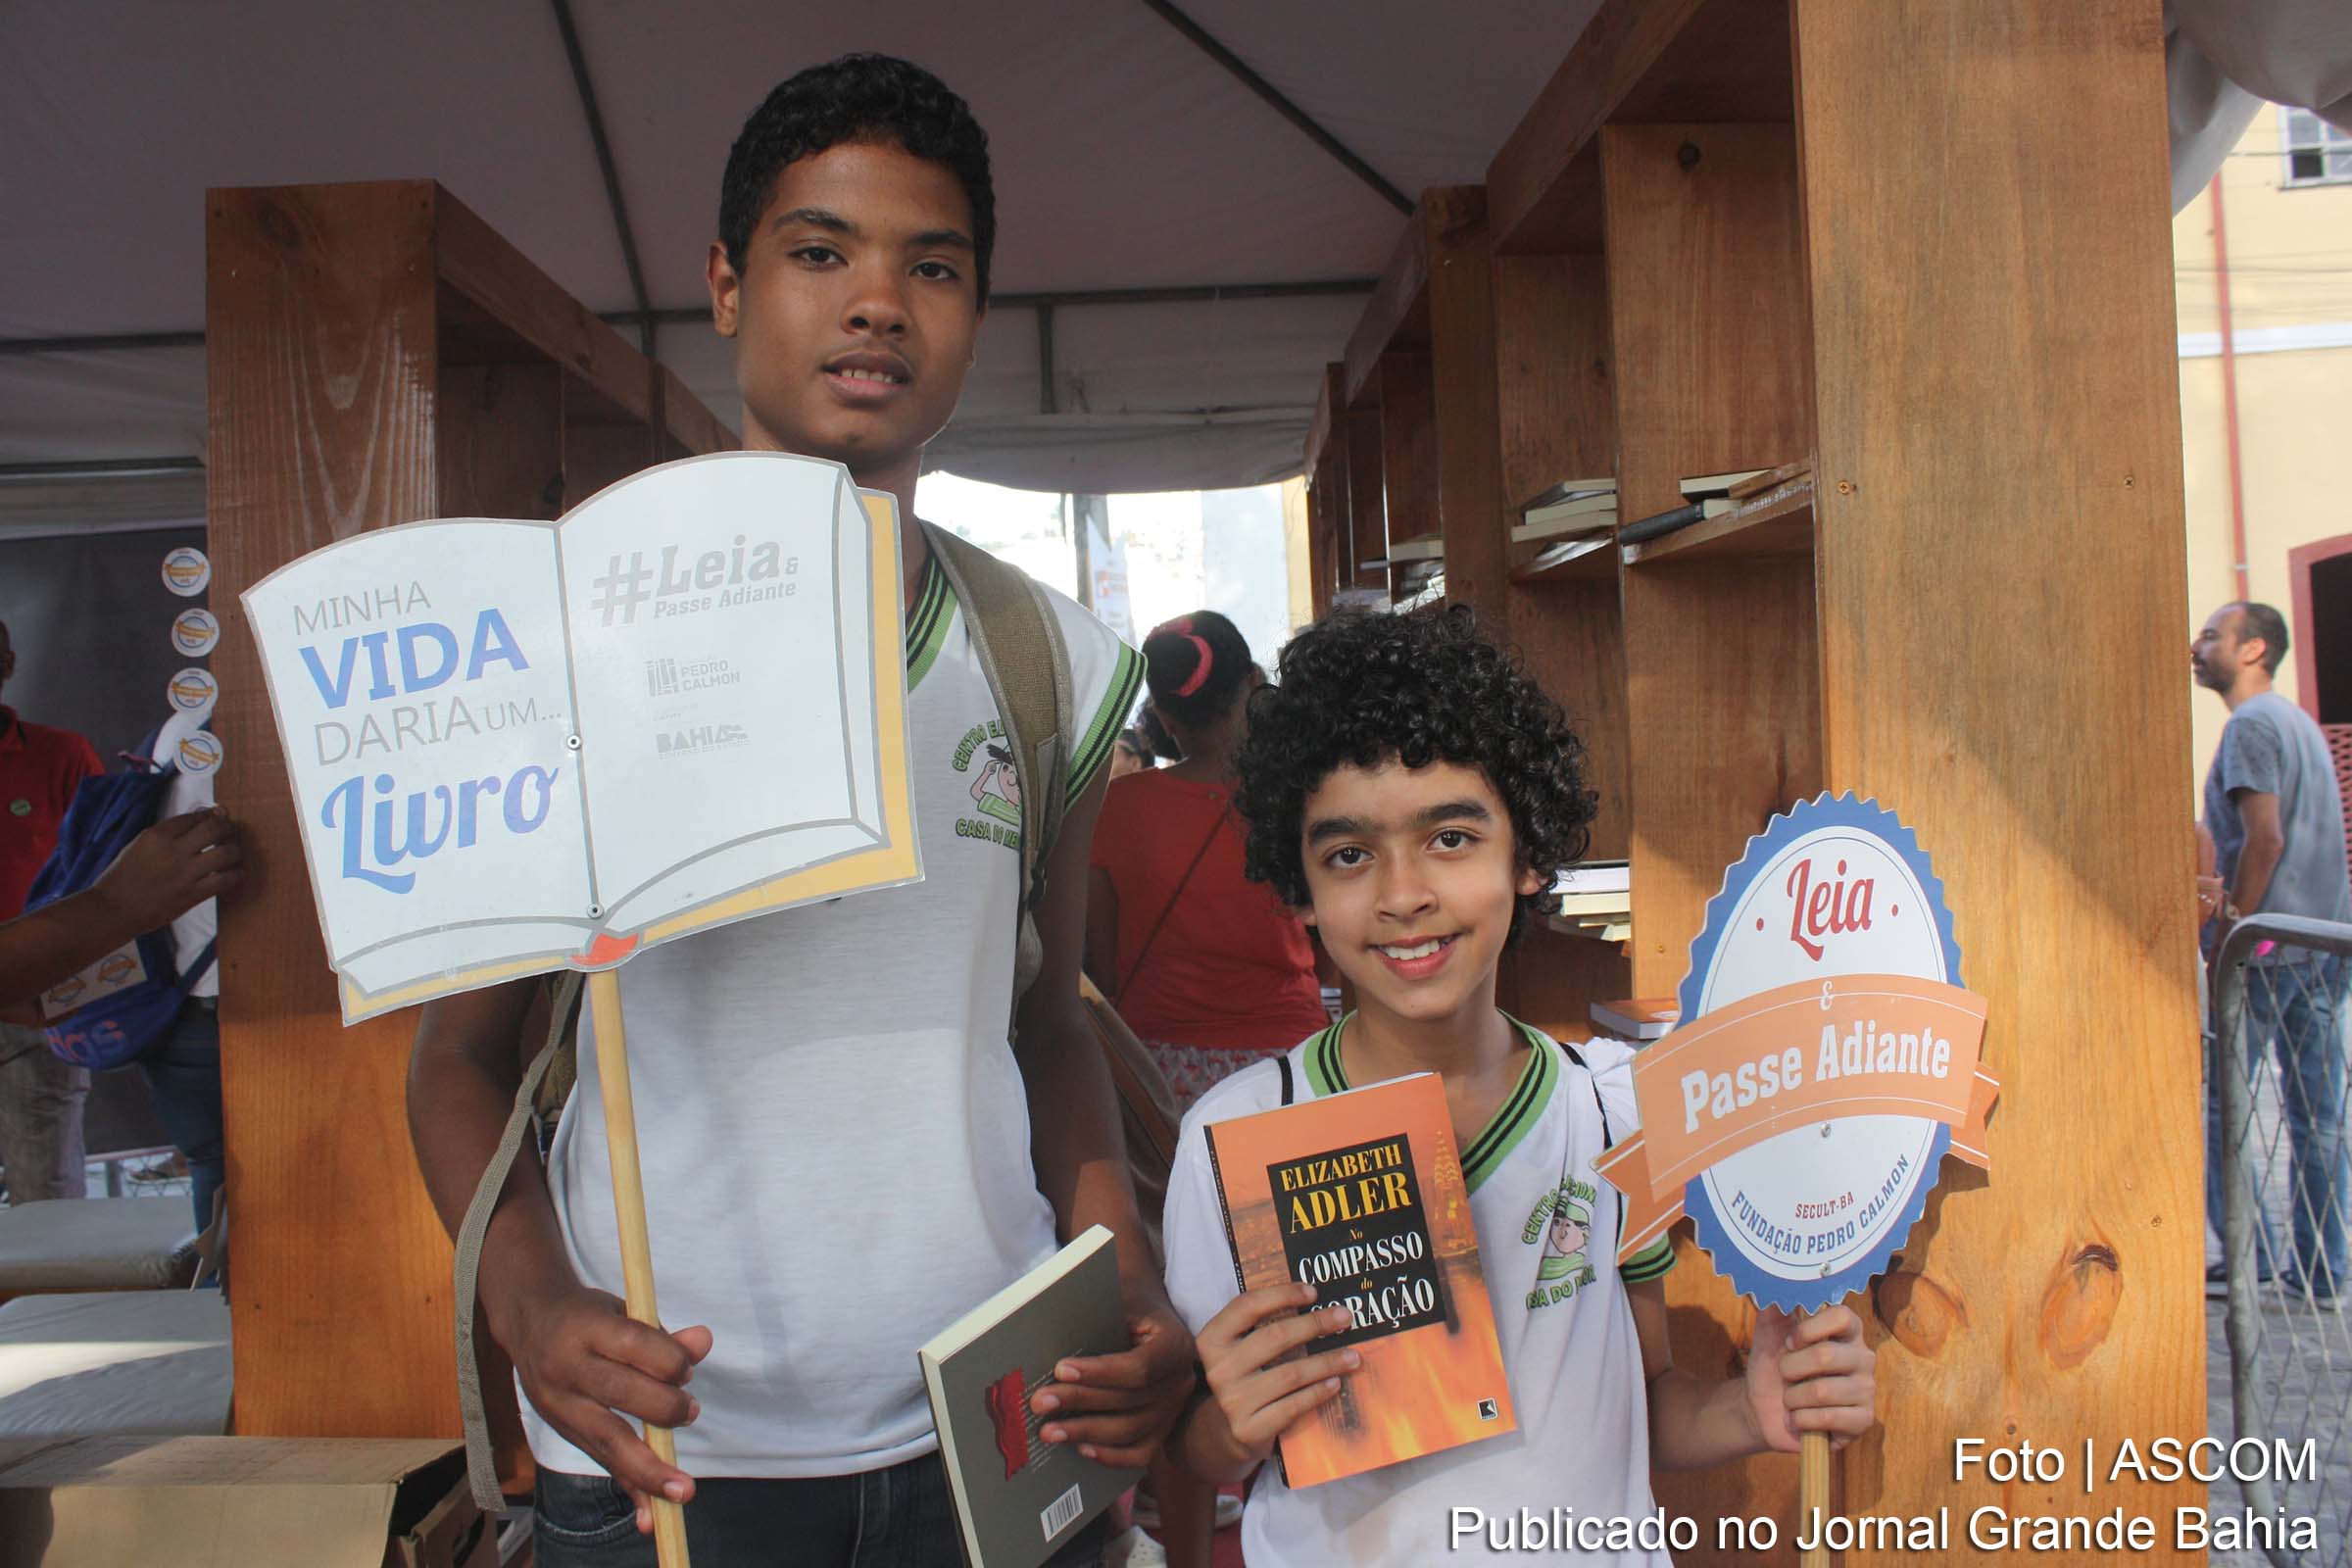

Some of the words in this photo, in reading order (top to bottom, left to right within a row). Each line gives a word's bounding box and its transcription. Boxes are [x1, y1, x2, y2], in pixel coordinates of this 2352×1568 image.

[293, 580, 431, 635] MINHA
[589, 534, 780, 628] #Leia
[654, 596, 712, 619] Passe
[717, 581, 797, 608] Adiante
[299, 608, 530, 709] VIDA
[681, 659, 729, 677] PEDRO
[682, 671, 741, 691] CALMON
[314, 696, 481, 766] DARIA
[321, 765, 560, 894] Livro
[956, 818, 991, 841] CASA
[1787, 858, 1874, 961] Leia
[1681, 1047, 1802, 1134] Passe
[1816, 1019, 1950, 1082] Adiante
[1280, 1144, 1403, 1192] ELIZABETH
[1290, 1171, 1412, 1234] ADLER
[1521, 1188, 1561, 1245] CENTRO
[1732, 1190, 1802, 1254] FUNDAÇÃO
[1806, 1221, 1855, 1254] PEDRO
[1859, 1153, 1909, 1229] CALMON
[1795, 1191, 1854, 1219] SECULT-BA
[1298, 1231, 1424, 1287] COMPASSO
[1349, 1227, 1363, 1242] No
[1310, 1274, 1435, 1339] RAÇÃO
[1360, 1277, 1373, 1291] do
[1550, 1280, 1574, 1303] DO
